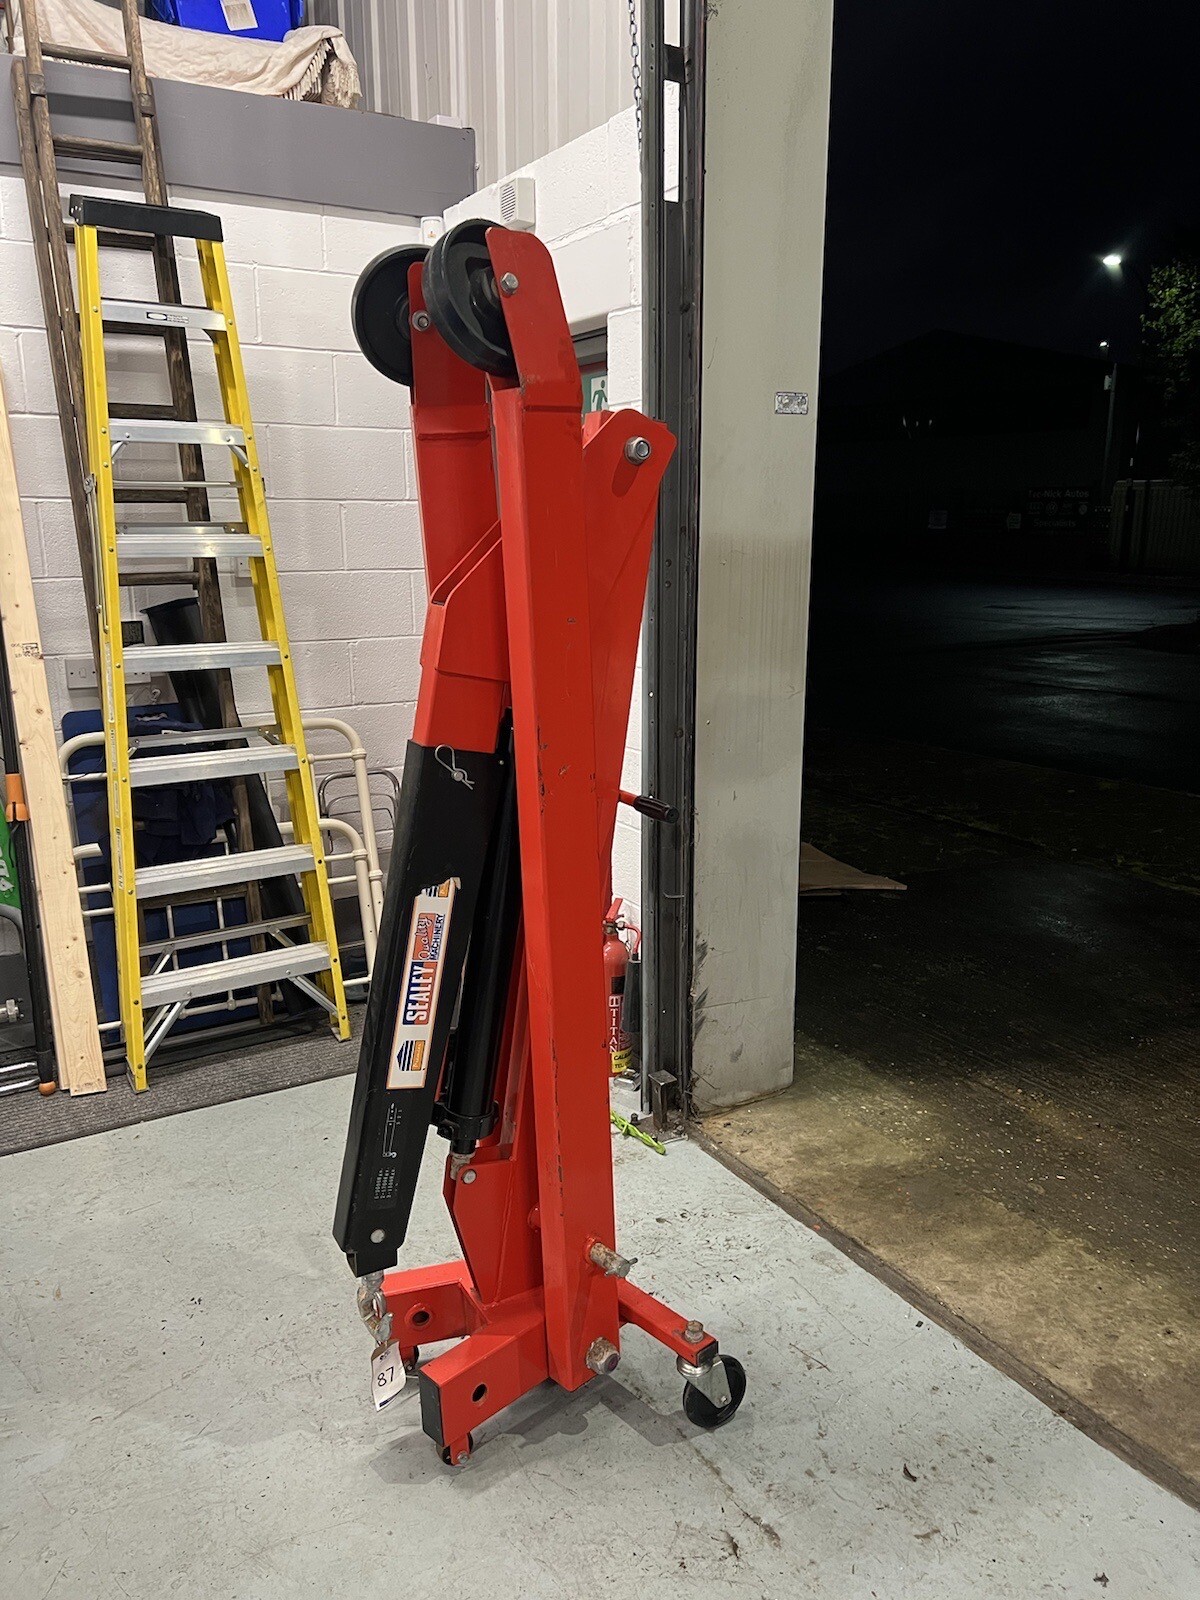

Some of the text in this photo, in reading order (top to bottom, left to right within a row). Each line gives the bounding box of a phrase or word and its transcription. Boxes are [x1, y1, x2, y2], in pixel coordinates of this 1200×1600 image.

[1064, 489, 1090, 498] Autos
[415, 916, 433, 960] Quality
[429, 914, 445, 960] MACHINERY
[406, 965, 435, 1021] SEALEY
[609, 1008, 618, 1053] TITAN
[377, 1365, 394, 1387] 87
